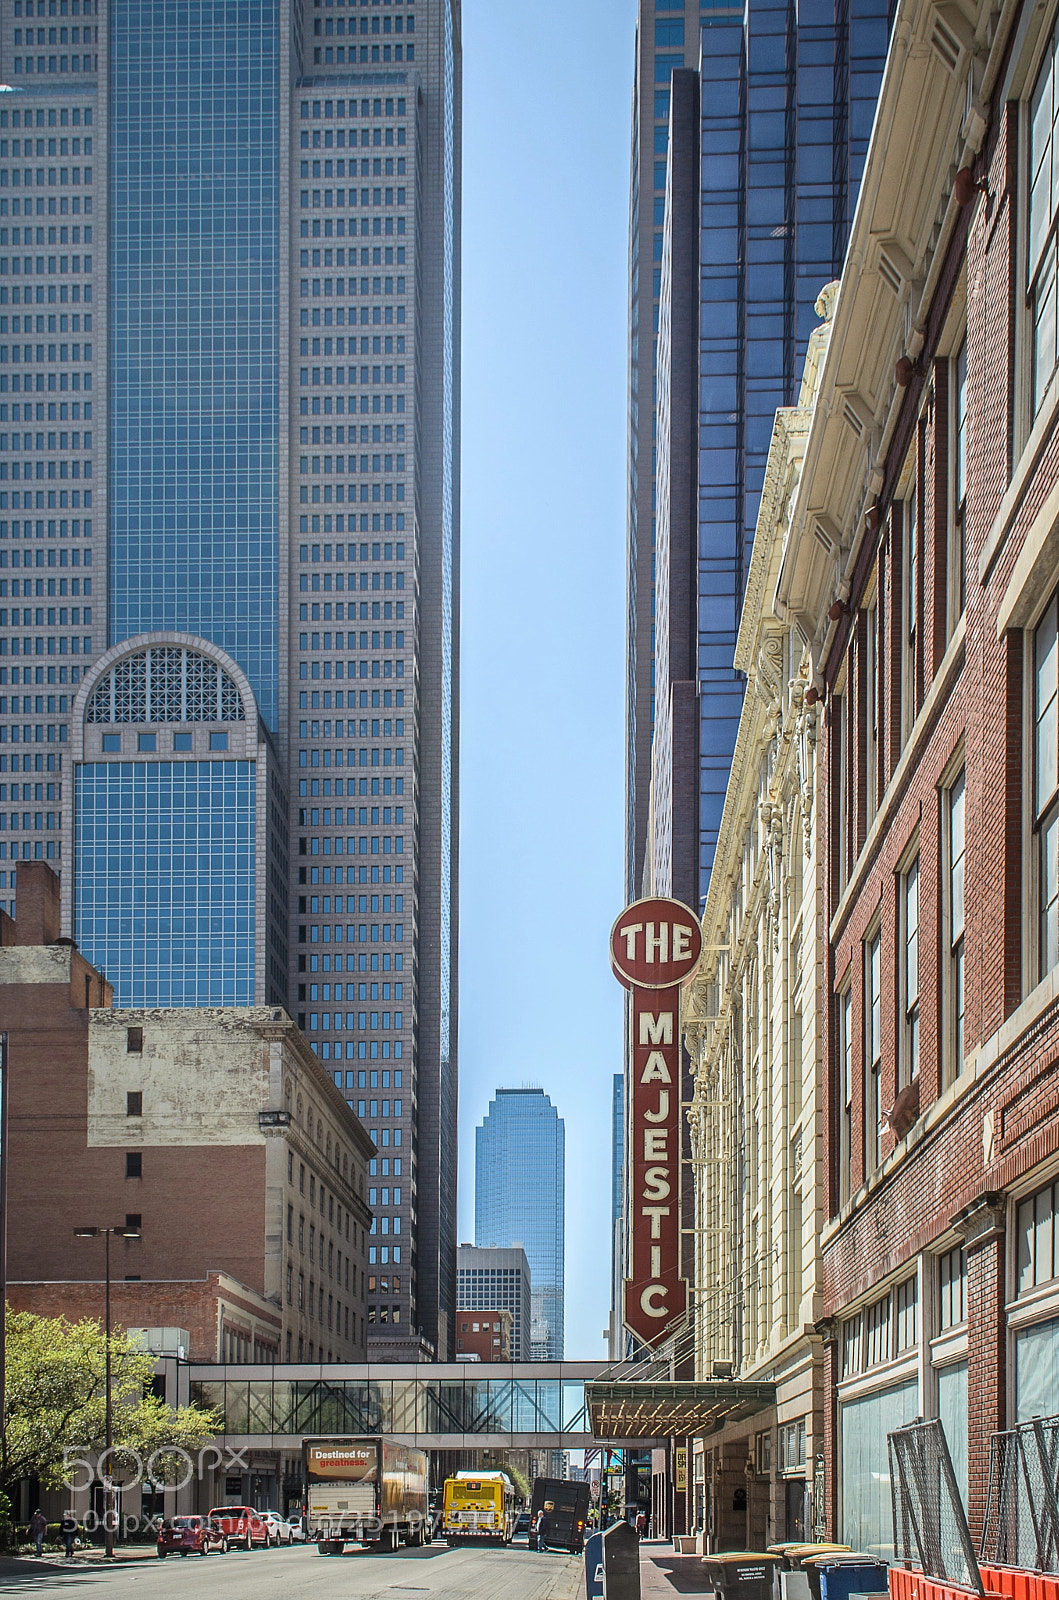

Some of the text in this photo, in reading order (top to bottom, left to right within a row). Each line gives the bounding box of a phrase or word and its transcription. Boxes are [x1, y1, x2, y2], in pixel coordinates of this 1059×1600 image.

[620, 921, 693, 964] THE
[639, 1011, 673, 1318] MAJESTIC
[315, 1450, 371, 1459] Destined for
[320, 1459, 368, 1468] greatness.
